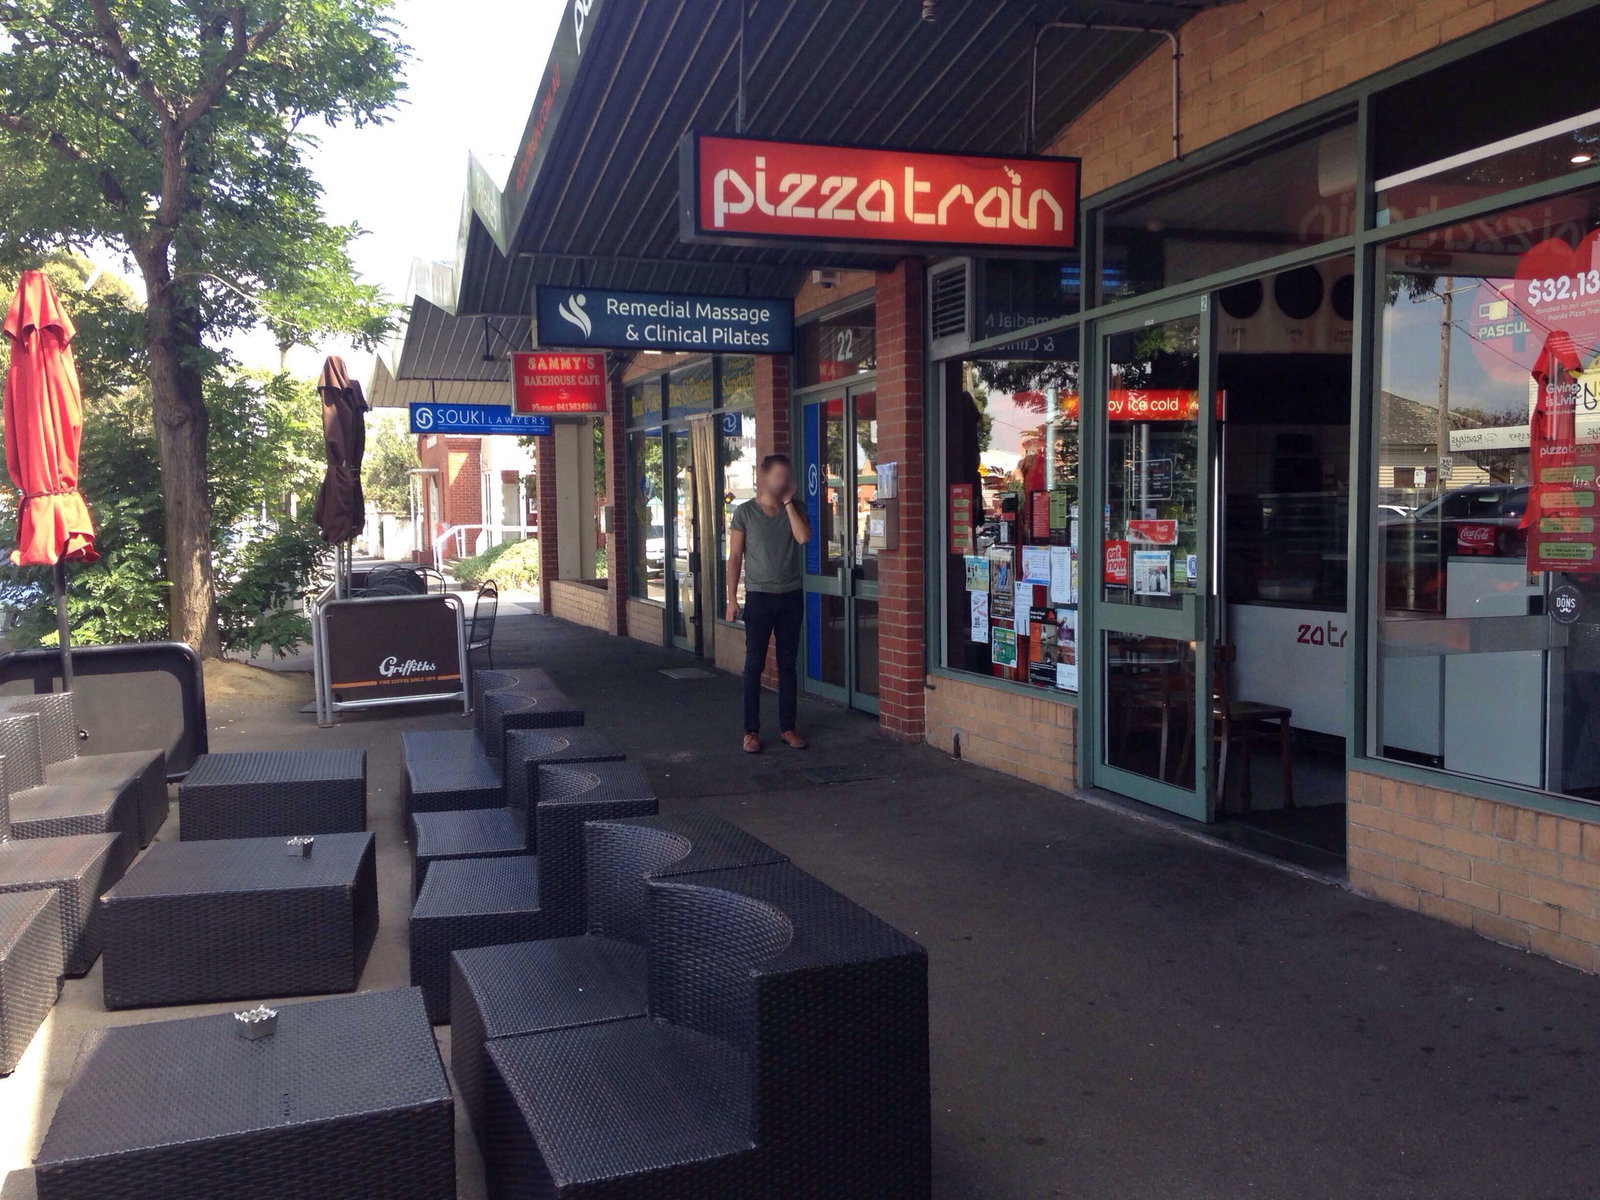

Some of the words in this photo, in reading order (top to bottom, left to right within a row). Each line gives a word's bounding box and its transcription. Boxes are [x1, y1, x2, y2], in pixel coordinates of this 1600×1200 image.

[606, 298, 690, 318] Remedial
[696, 303, 770, 324] Massage
[626, 324, 639, 341] &
[644, 325, 707, 343] Clinical
[712, 327, 769, 345] Pilates
[837, 329, 853, 362] 22
[528, 357, 595, 370] SAMMY'S
[524, 375, 577, 386] BAKEHOUSE
[578, 374, 600, 385] CAFE
[1127, 397, 1148, 411] ice
[1150, 397, 1179, 411] cold
[437, 409, 485, 424] SOUKI
[488, 416, 545, 425] LAWYERS
[1107, 545, 1121, 560] eat
[1107, 560, 1126, 572] now
[1556, 597, 1576, 608] DONS
[379, 656, 436, 677] Griffiths
